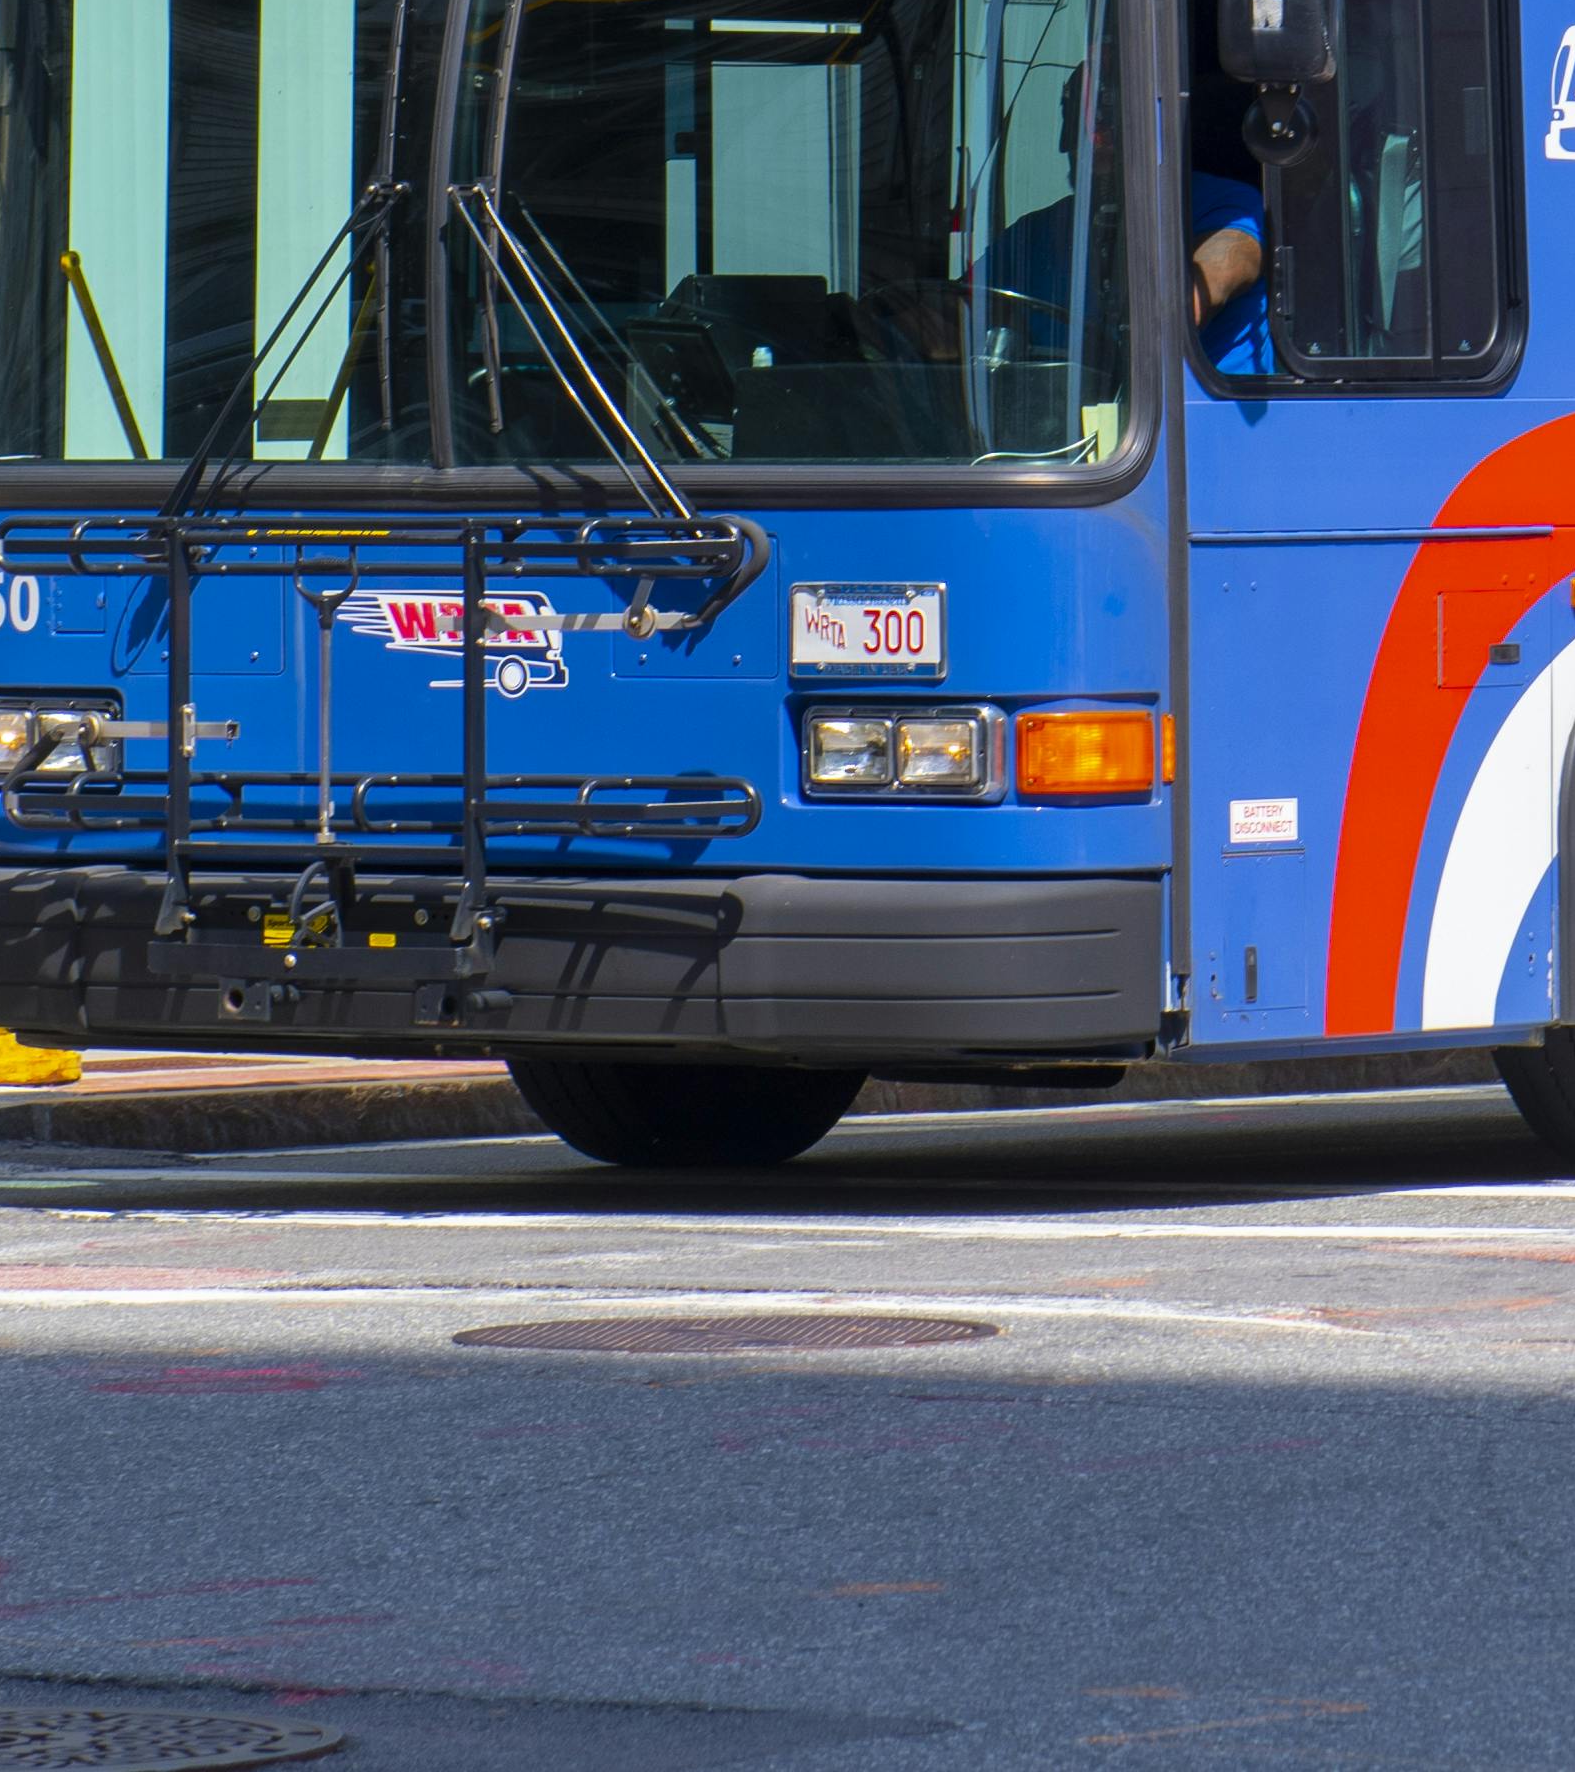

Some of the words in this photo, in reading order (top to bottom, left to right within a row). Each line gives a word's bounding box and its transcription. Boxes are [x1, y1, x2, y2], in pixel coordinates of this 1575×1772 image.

[805, 606, 847, 650] WRTA
[862, 608, 925, 655] 300
[1243, 804, 1284, 819] BATTERY
[1234, 819, 1293, 835] DISCONNECT
